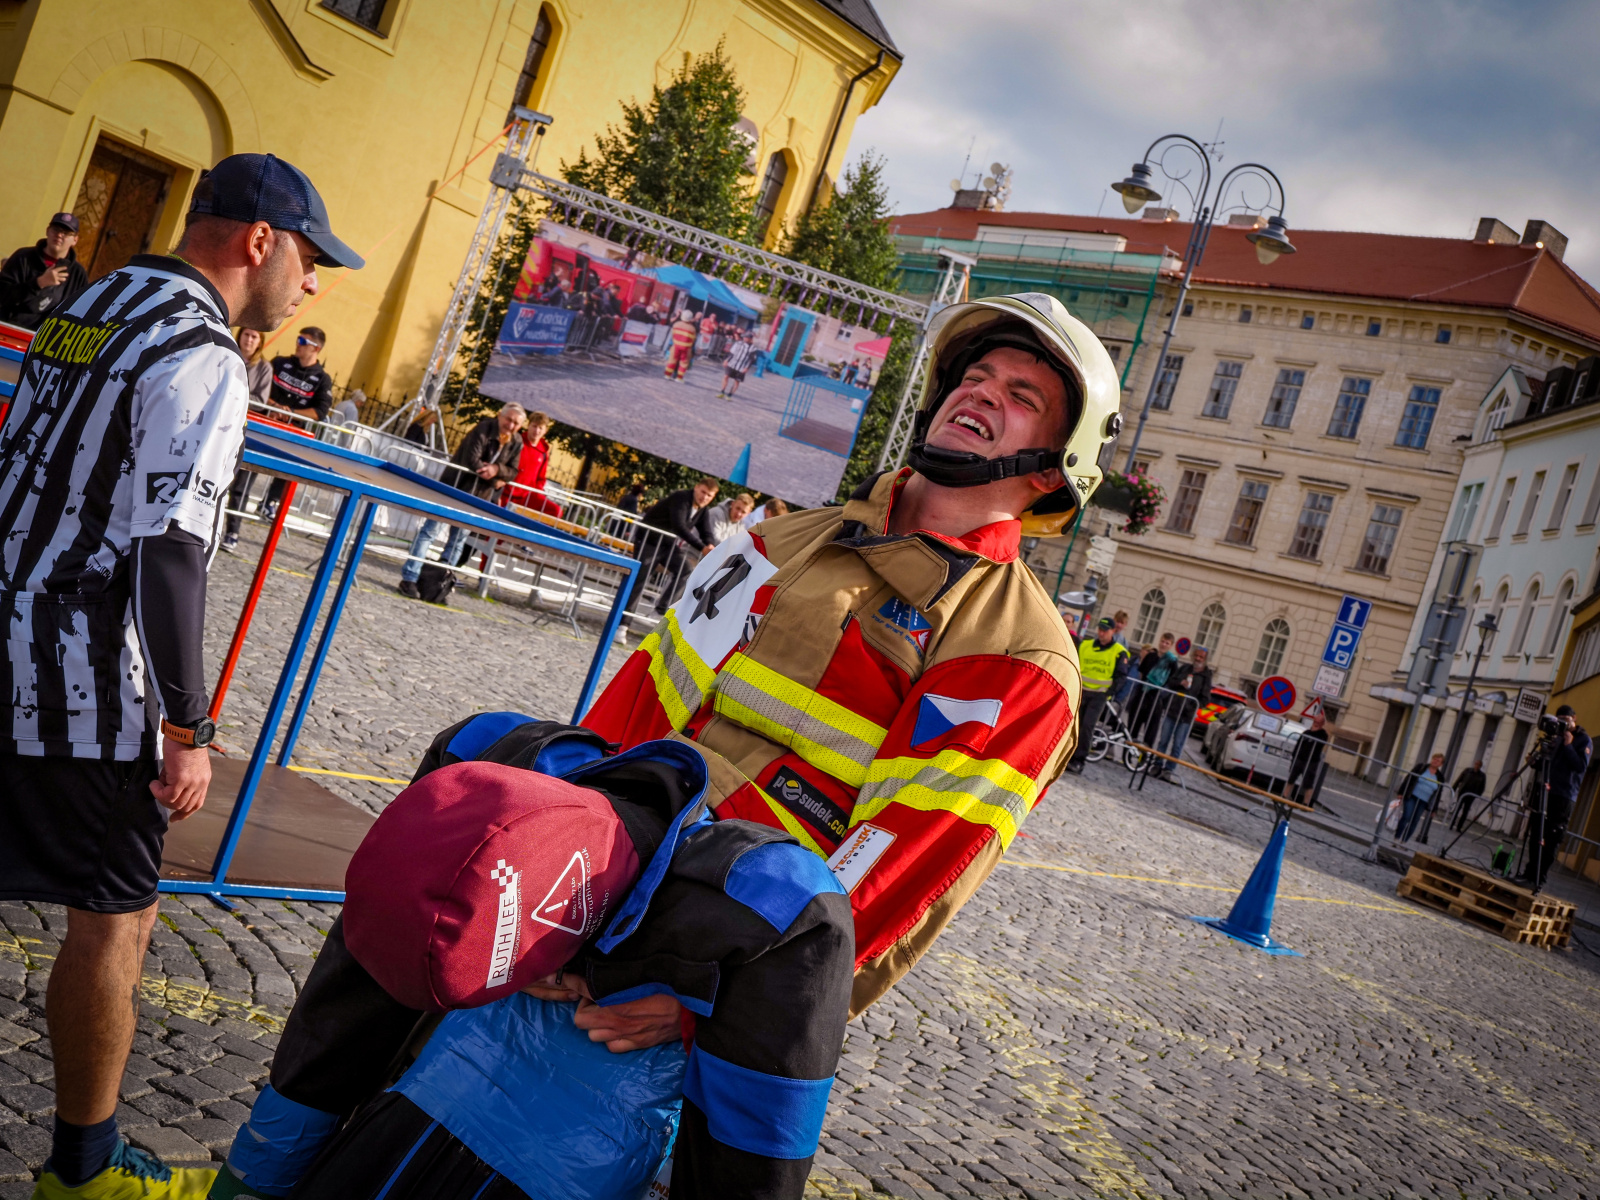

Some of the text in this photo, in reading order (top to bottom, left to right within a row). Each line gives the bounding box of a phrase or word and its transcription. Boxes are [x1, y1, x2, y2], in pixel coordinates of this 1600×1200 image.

[1332, 630, 1352, 652] P
[832, 826, 872, 873] TECHNIK
[581, 847, 594, 933] www.ruthlee.co.uk
[492, 895, 515, 980] RUTH LEE
[511, 922, 523, 970] PROFESSIONALS
